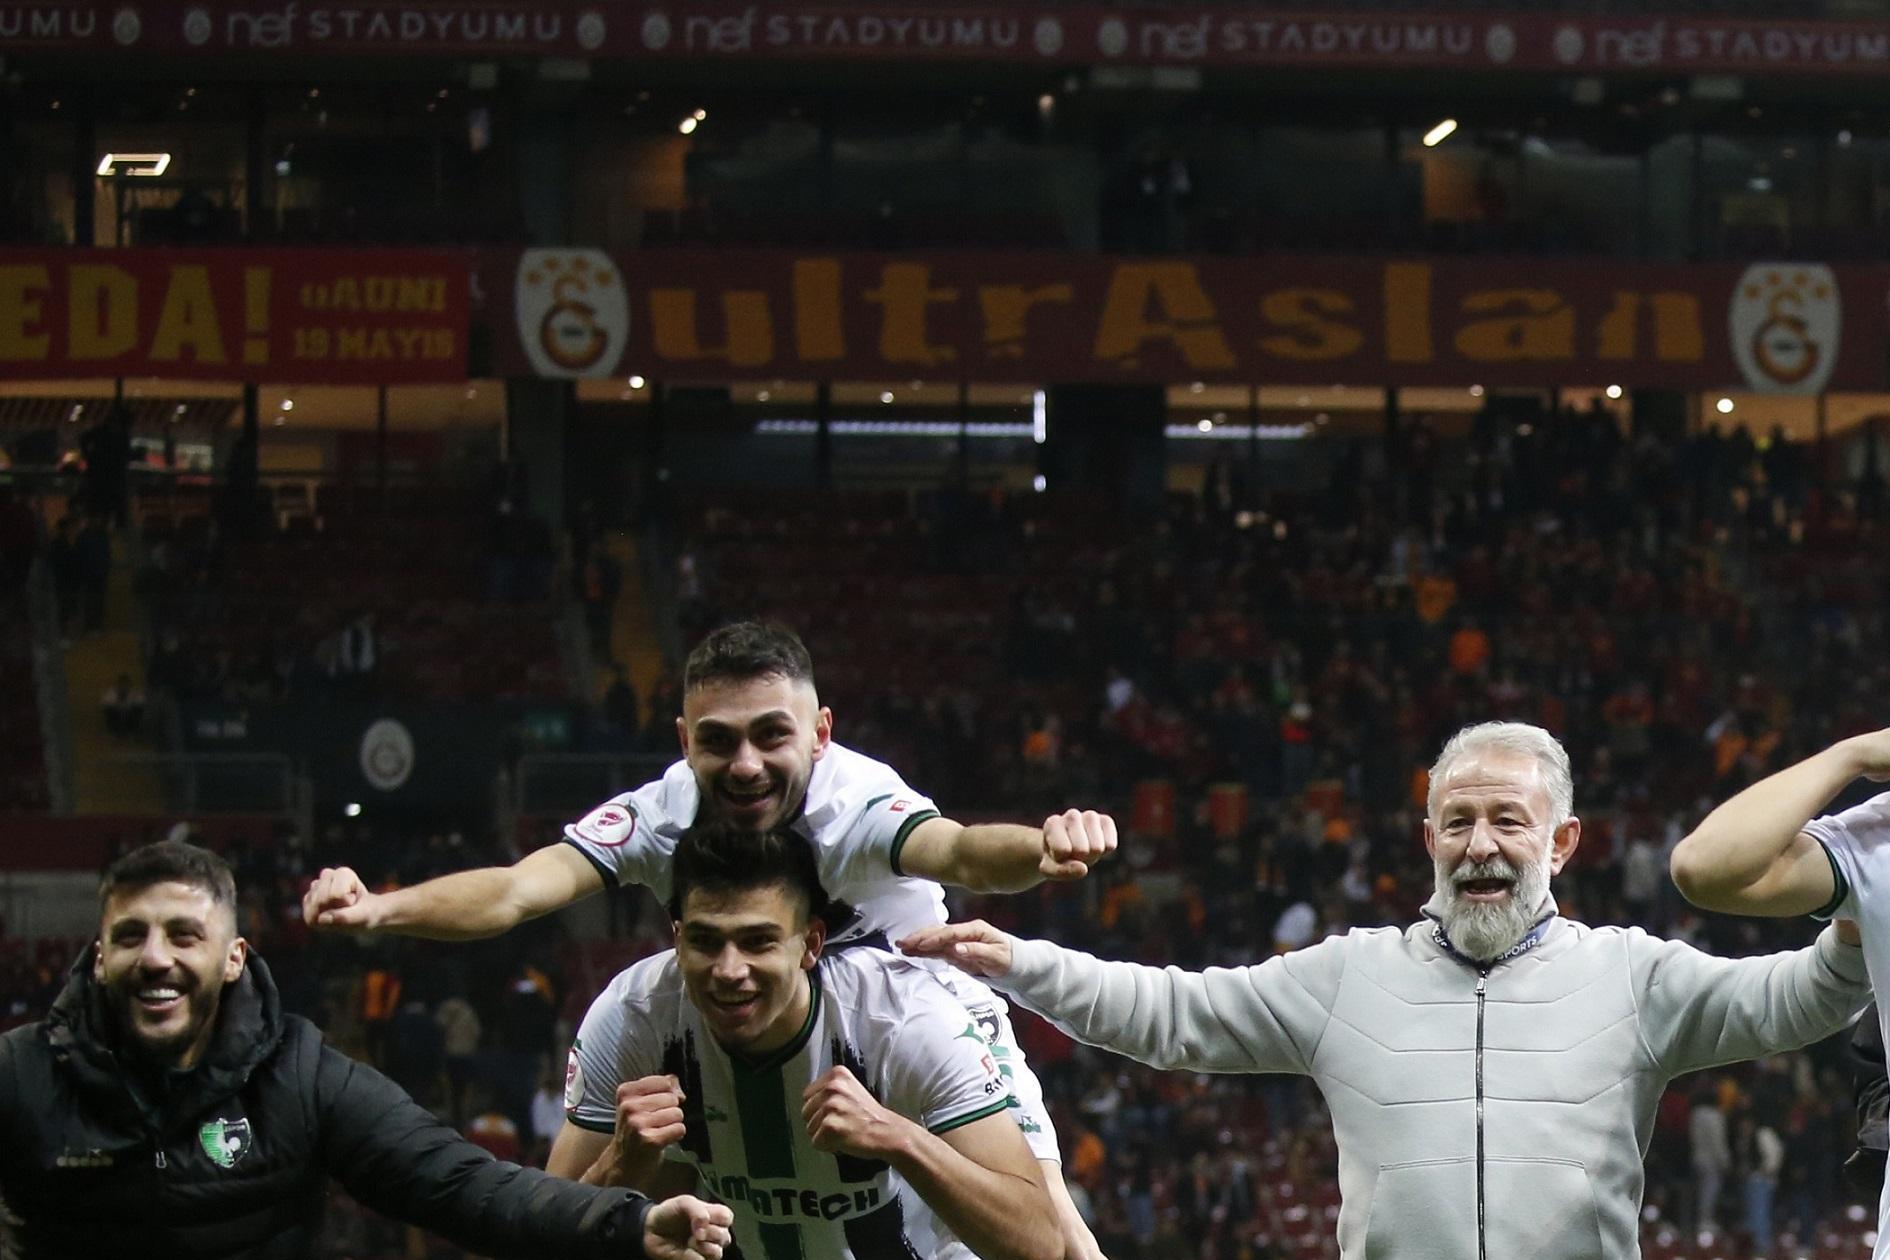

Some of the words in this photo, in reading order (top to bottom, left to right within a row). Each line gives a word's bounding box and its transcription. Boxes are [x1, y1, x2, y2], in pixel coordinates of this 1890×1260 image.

[226, 8, 293, 48] nef
[307, 10, 561, 42] STADYUMU
[686, 10, 755, 52] nef
[765, 15, 1019, 47] STADYUMU
[1141, 15, 1211, 58] nef
[1222, 19, 1473, 55] STADYUMU
[1596, 21, 1668, 66] nef
[648, 258, 1704, 369] ultrAslan
